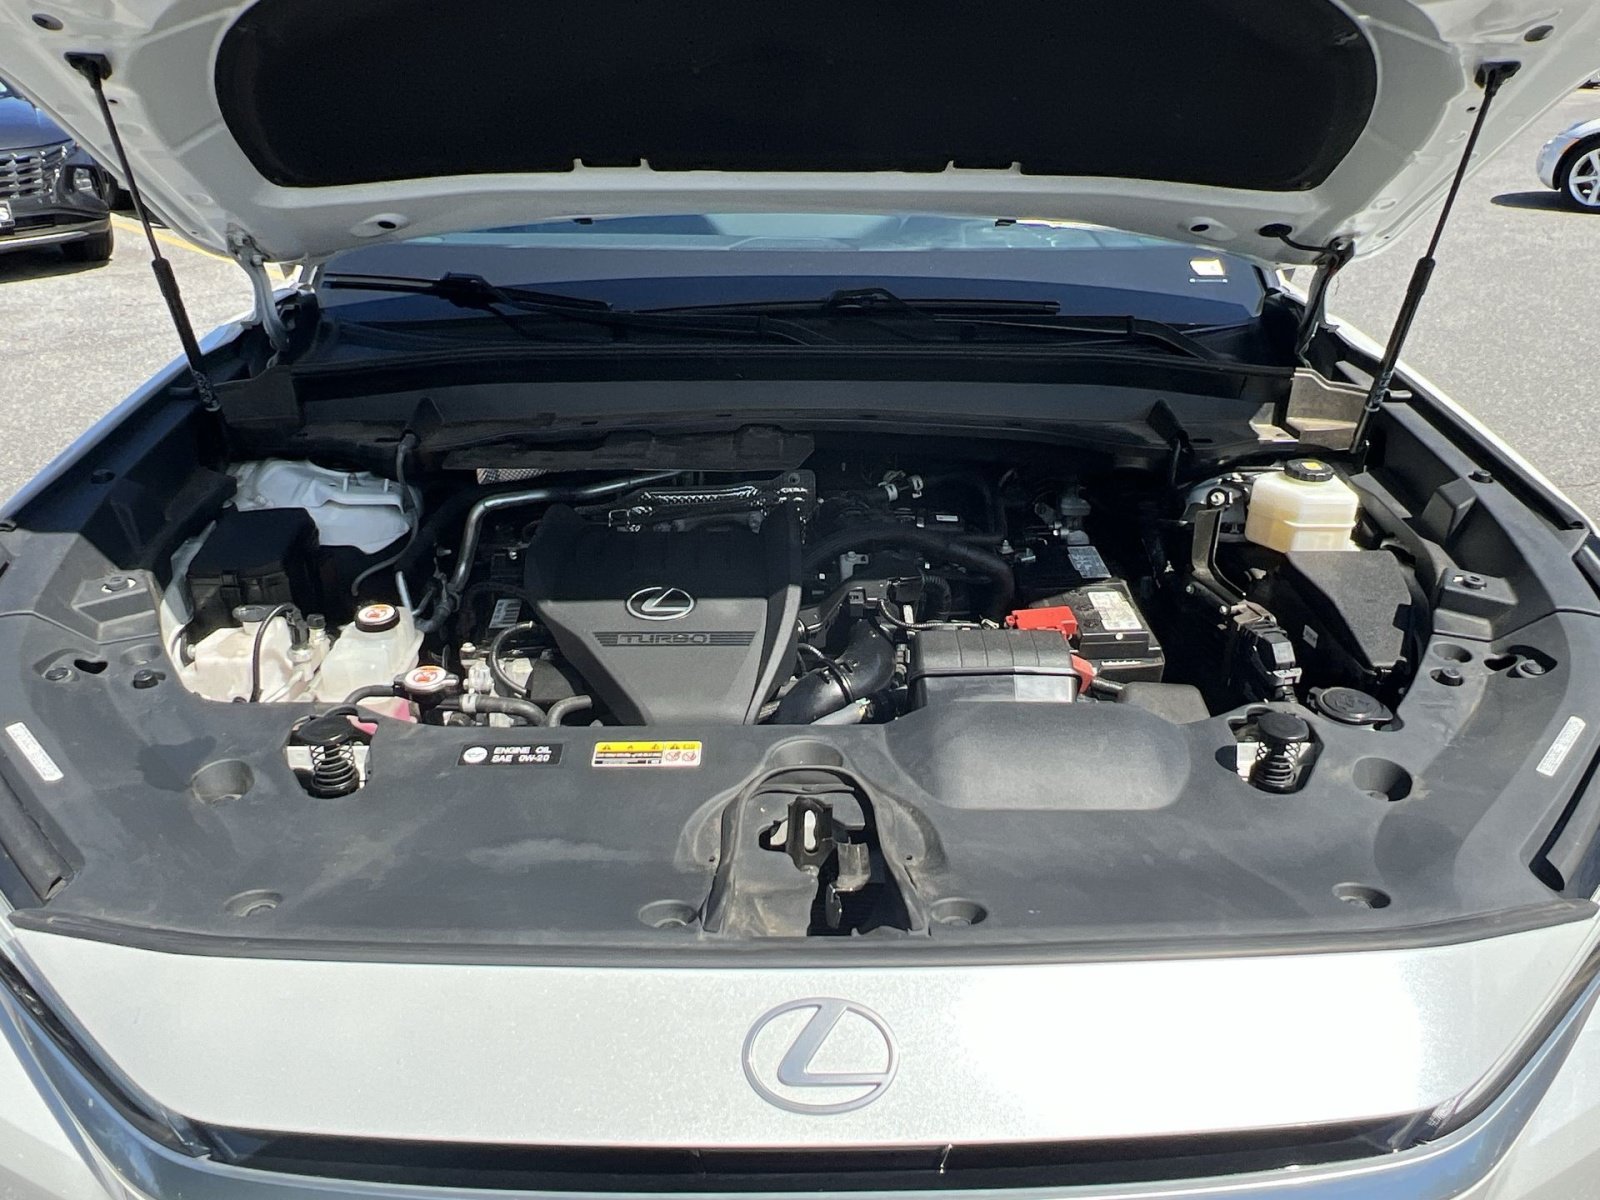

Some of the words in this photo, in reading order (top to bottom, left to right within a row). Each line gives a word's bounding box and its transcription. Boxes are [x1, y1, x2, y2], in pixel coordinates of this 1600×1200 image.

[618, 633, 708, 645] TURBO
[493, 746, 531, 754] ENGINE
[535, 746, 552, 754] OIL
[491, 754, 514, 763] SAE
[518, 754, 550, 763] 0W-20
